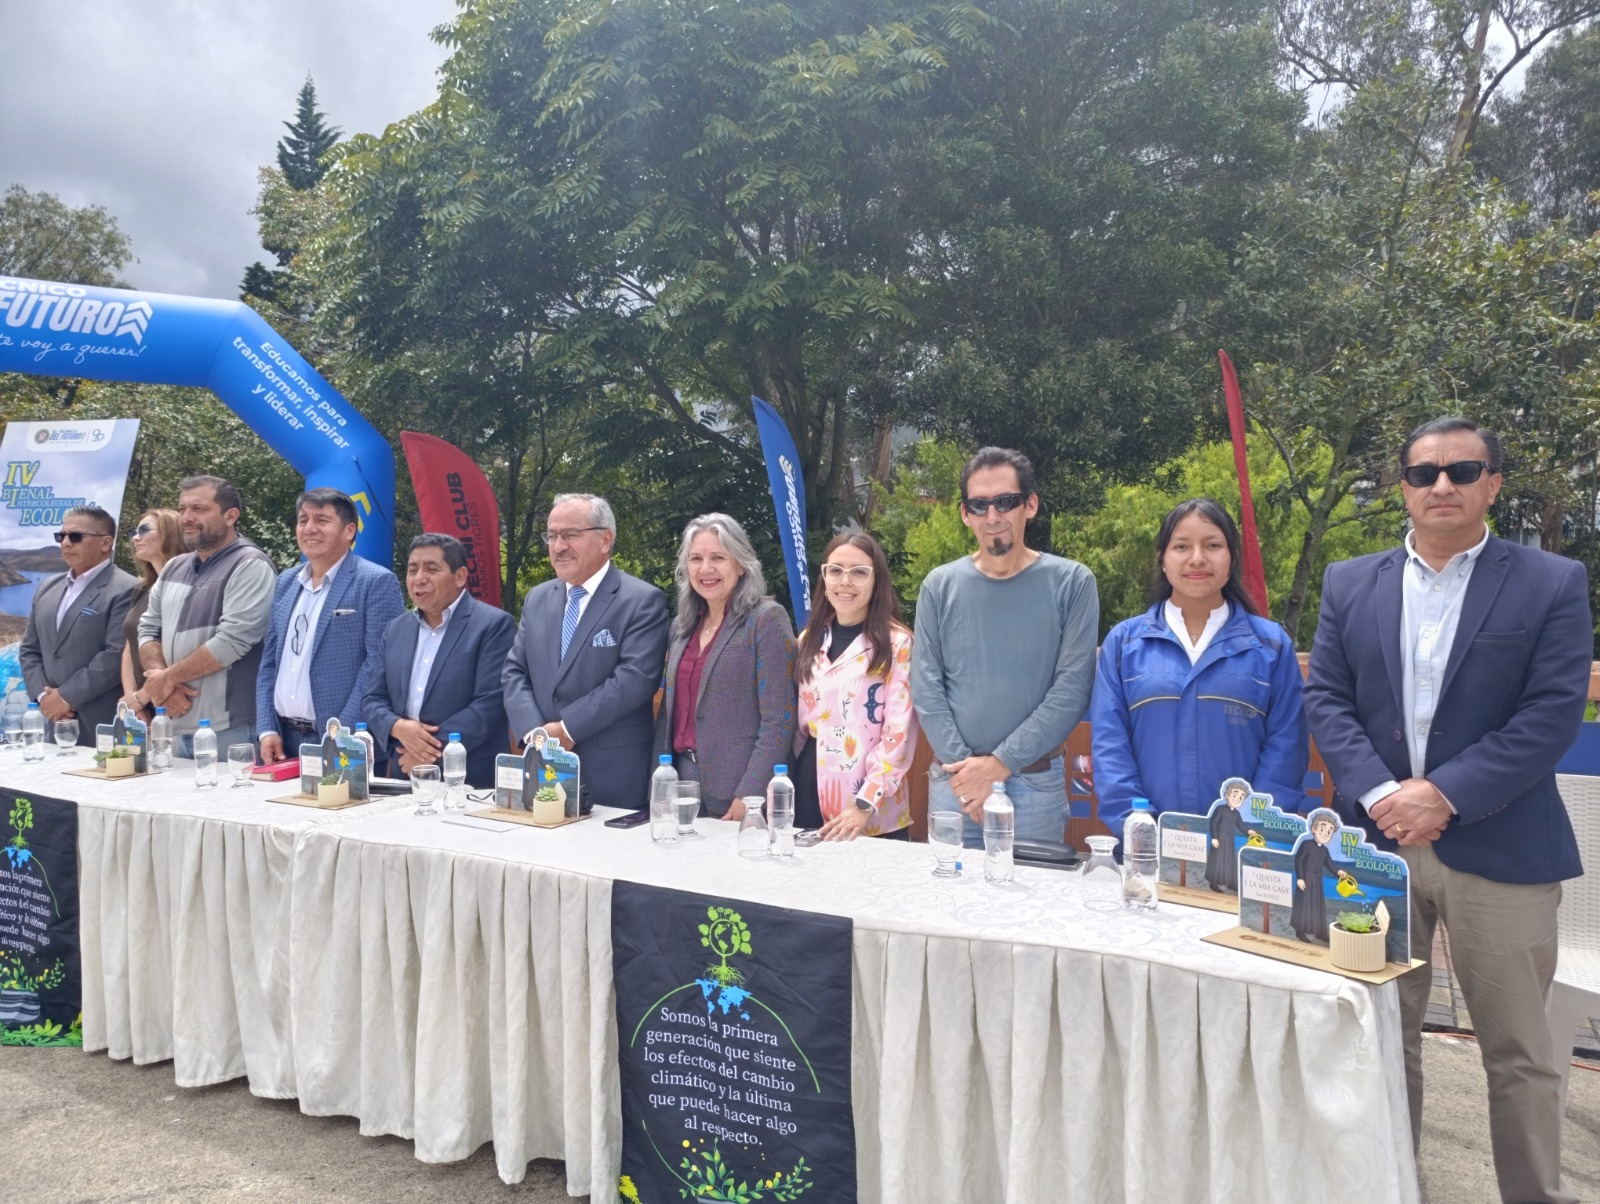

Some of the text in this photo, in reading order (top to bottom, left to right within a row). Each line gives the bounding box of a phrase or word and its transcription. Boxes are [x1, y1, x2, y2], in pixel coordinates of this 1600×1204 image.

[0, 290, 125, 336] FUTURO
[60, 342, 75, 351] a
[232, 336, 350, 449] transformar, inspirar
[260, 342, 348, 427] Educamos para
[251, 383, 304, 431] y liderar
[4, 461, 40, 486] IV
[20, 508, 62, 525] ECOL
[447, 472, 470, 531] CLUB
[468, 502, 489, 599] VAMOS TIGRES
[1251, 797, 1267, 810] IV
[1341, 832, 1359, 847] IV
[1355, 858, 1402, 874] ECOLOGÍA
[21, 887, 31, 898] que
[33, 890, 50, 903] siente
[1249, 880, 1257, 888] LA
[1259, 882, 1271, 891] MIA
[18, 914, 23, 924] y
[30, 904, 50, 917] cambio
[37, 933, 50, 946] algo
[661, 1007, 778, 1046] Somos la primera
[646, 1030, 796, 1071] generación que siente
[644, 1047, 795, 1092] los efectos del cambio
[651, 1070, 792, 1112] climático y la última
[649, 1093, 797, 1135] que puede hacer algo
[684, 1115, 763, 1146] al respecto.
